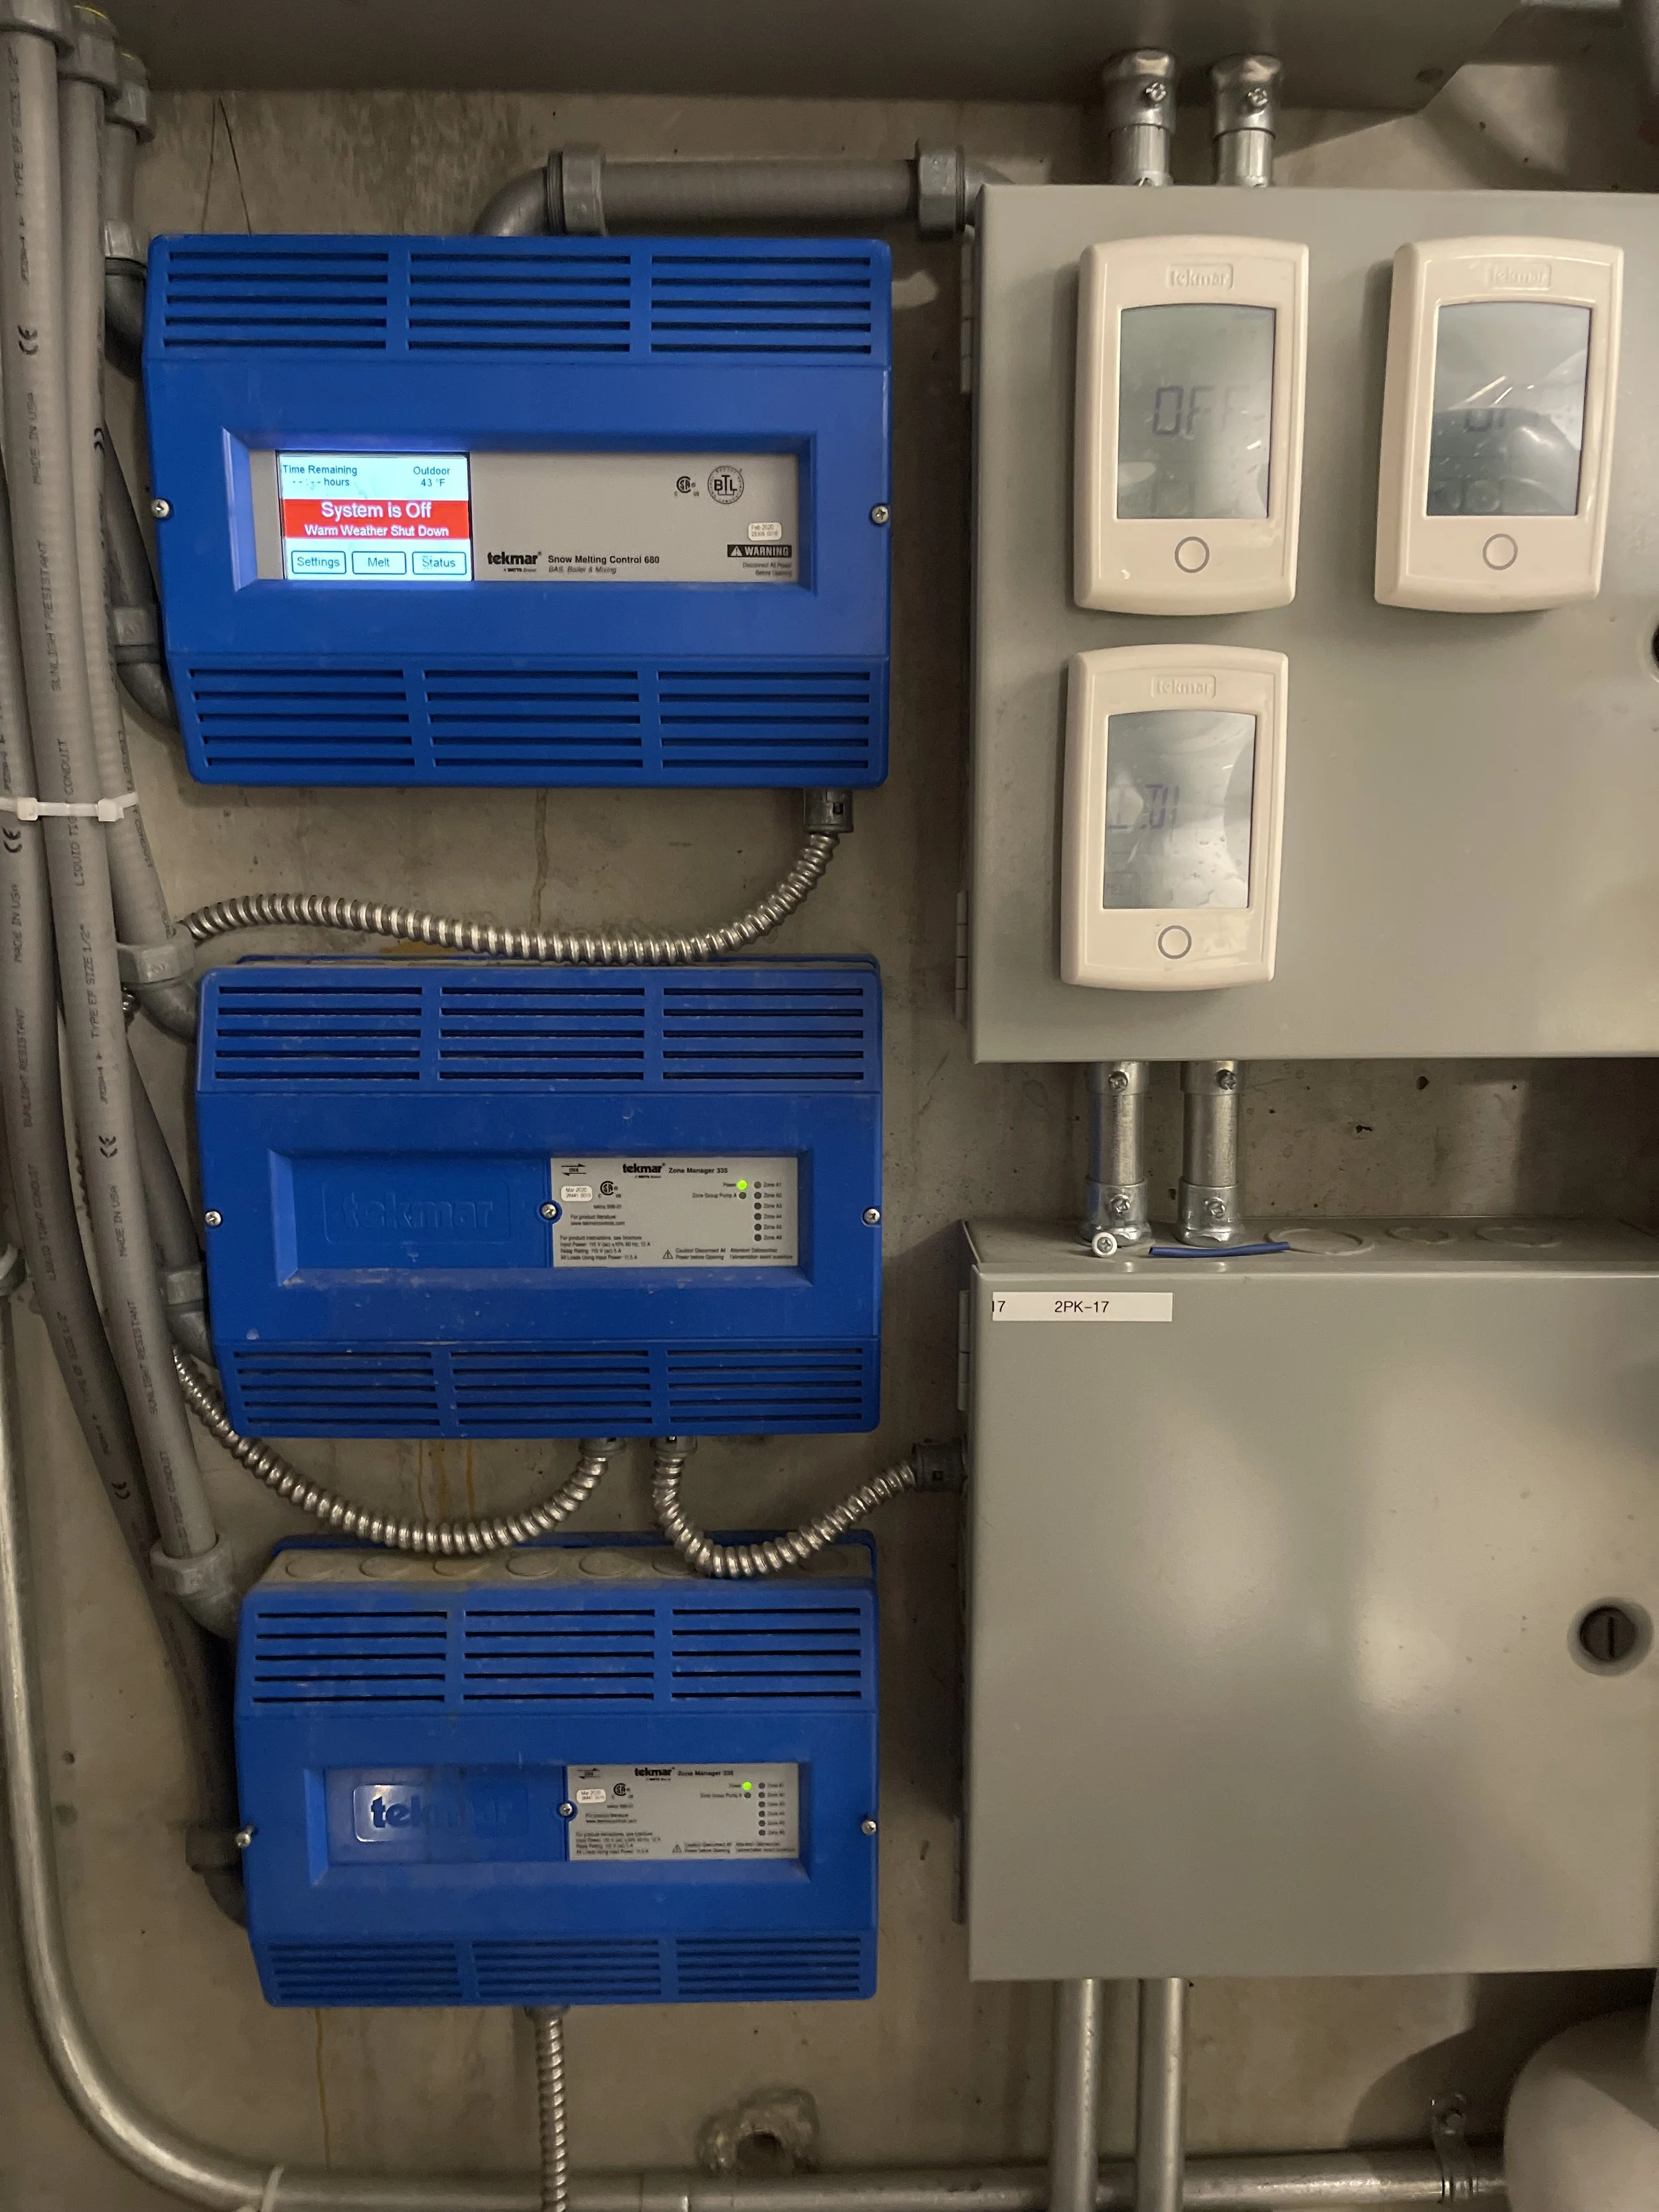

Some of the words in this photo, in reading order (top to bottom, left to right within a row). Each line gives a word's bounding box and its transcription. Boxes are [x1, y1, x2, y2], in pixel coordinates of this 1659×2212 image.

[283, 465, 305, 474] Time
[308, 465, 357, 476] Remaining
[413, 467, 450, 475] Outdoor
[324, 478, 350, 486] hours
[321, 502, 383, 522] System
[388, 502, 401, 518] is
[405, 502, 431, 518] Off
[305, 524, 337, 536] Warm
[340, 525, 388, 536] Weather
[391, 525, 414, 536] Shut
[418, 526, 449, 537] Down
[745, 546, 788, 556] WARNING
[297, 557, 340, 569] Settings
[368, 557, 390, 567] Melt
[422, 557, 456, 567] Status
[548, 555, 573, 564] Snow
[575, 555, 607, 565] Melting
[609, 555, 642, 564] Control
[595, 566, 616, 575] Mixing
[82, 956, 96, 985] SIZE
[89, 1009, 100, 1039] TYPE
[1054, 1301, 1110, 1312] 2PK-17
